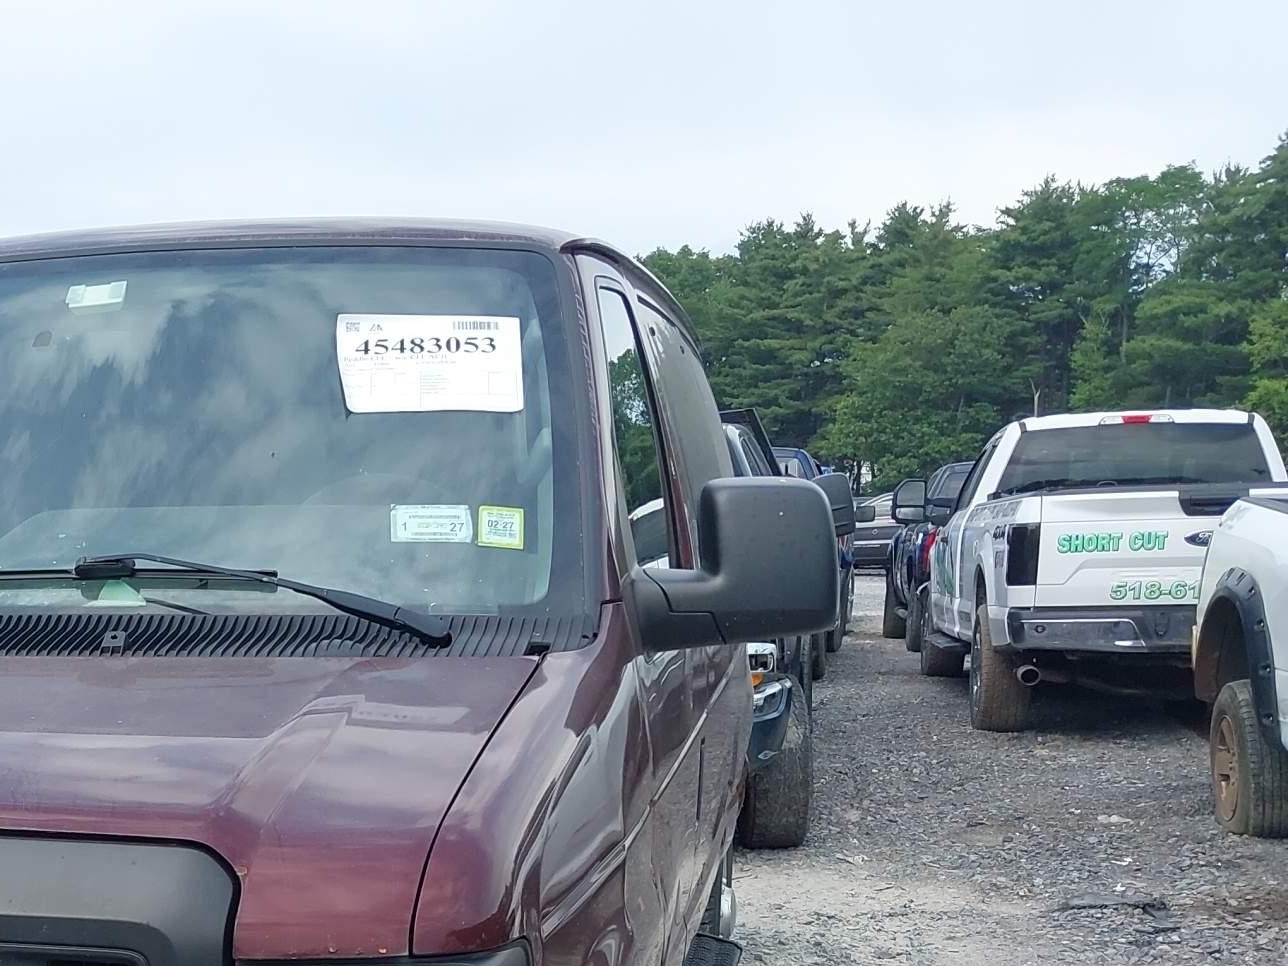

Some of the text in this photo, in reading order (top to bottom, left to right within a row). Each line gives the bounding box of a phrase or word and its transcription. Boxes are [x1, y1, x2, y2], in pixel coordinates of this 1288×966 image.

[354, 336, 497, 356] 45483053
[449, 522, 465, 533] 27
[1057, 530, 1169, 553] SHORT CUT
[1109, 579, 1201, 601] 518-61
